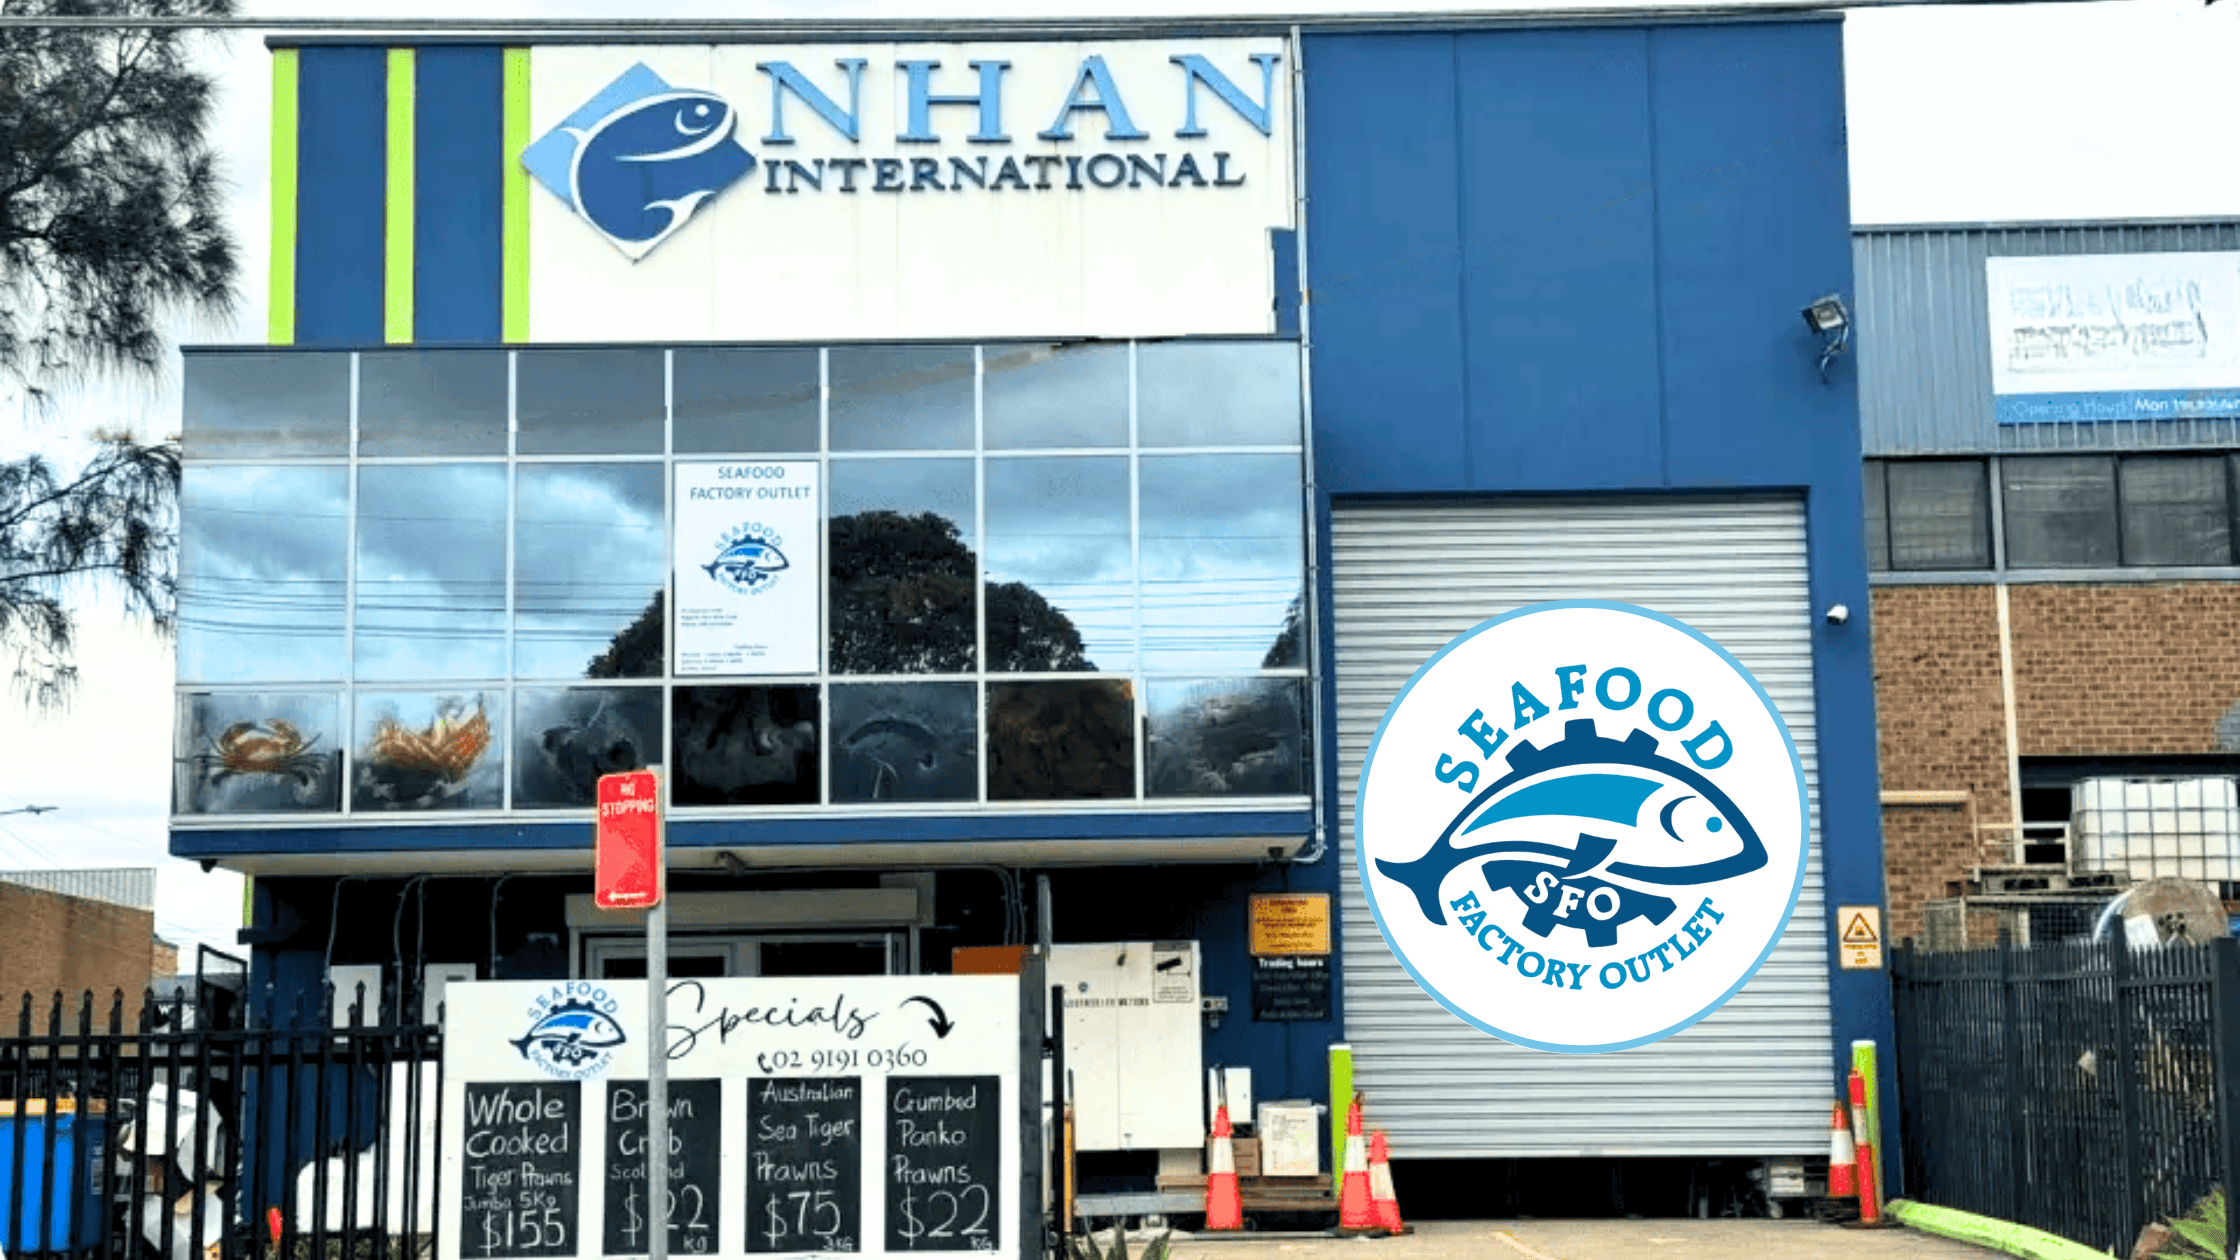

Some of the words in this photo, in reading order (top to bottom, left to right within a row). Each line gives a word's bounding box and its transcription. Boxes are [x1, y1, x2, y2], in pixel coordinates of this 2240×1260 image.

[755, 53, 1281, 146] NHAN
[763, 151, 1246, 194] INTERNATIONAL
[717, 466, 785, 479] SEAFOOD
[690, 486, 752, 500] FACTORY
[756, 486, 811, 500] OUTLET
[527, 981, 618, 1019] SEAFOOD
[665, 980, 880, 1060] Specials
[772, 1051, 803, 1068] 02
[811, 1049, 859, 1073] 9191
[867, 1041, 928, 1073] 0360
[468, 1087, 566, 1128] Whole
[611, 1088, 694, 1122] Brwn
[759, 1079, 854, 1103] Australian
[466, 1121, 568, 1158] Cooked
[619, 1129, 682, 1156] Crb
[757, 1114, 797, 1141] Sea
[804, 1112, 855, 1146] Tiger
[896, 1119, 967, 1147] Panko
[469, 1164, 516, 1195] Tiger
[752, 1150, 838, 1182] Prawns
[892, 1154, 971, 1184] Prawns
[477, 1208, 566, 1257] $155
[761, 1189, 841, 1249] $75
[897, 1184, 990, 1248] $22
